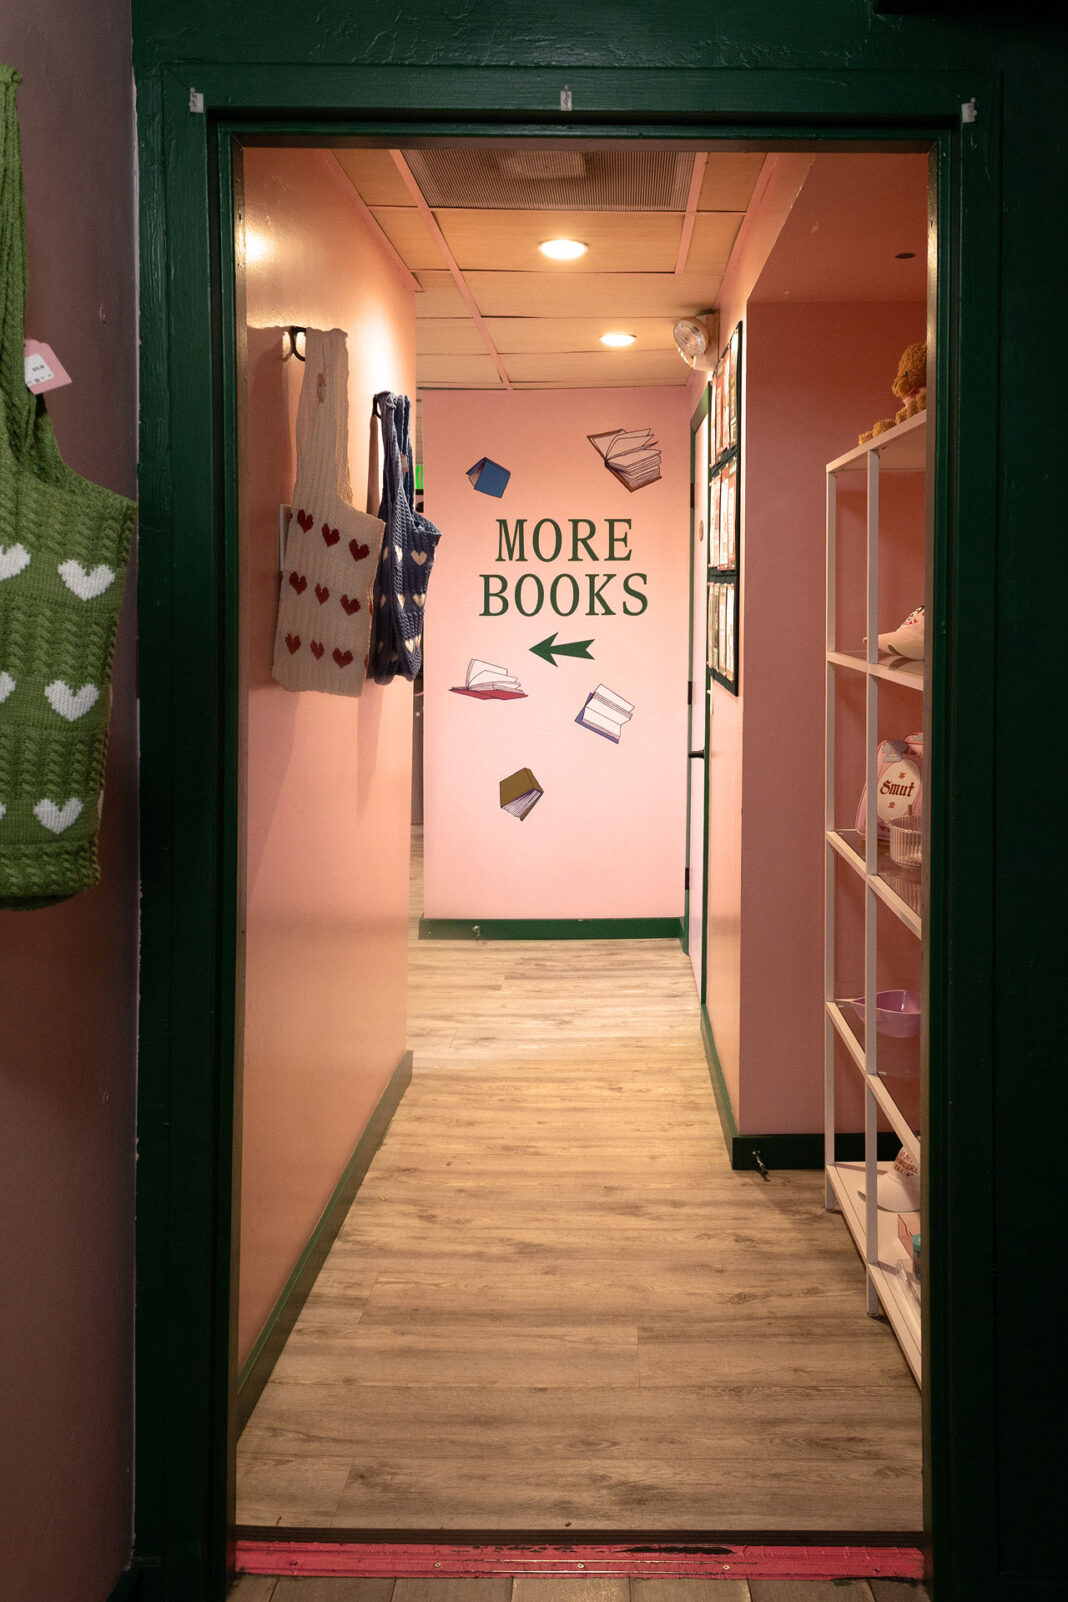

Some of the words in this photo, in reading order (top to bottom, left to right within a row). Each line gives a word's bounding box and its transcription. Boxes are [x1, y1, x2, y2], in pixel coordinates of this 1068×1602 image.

[495, 518, 632, 562] MORE
[479, 573, 648, 617] BOOKS
[880, 780, 915, 797] Smut
